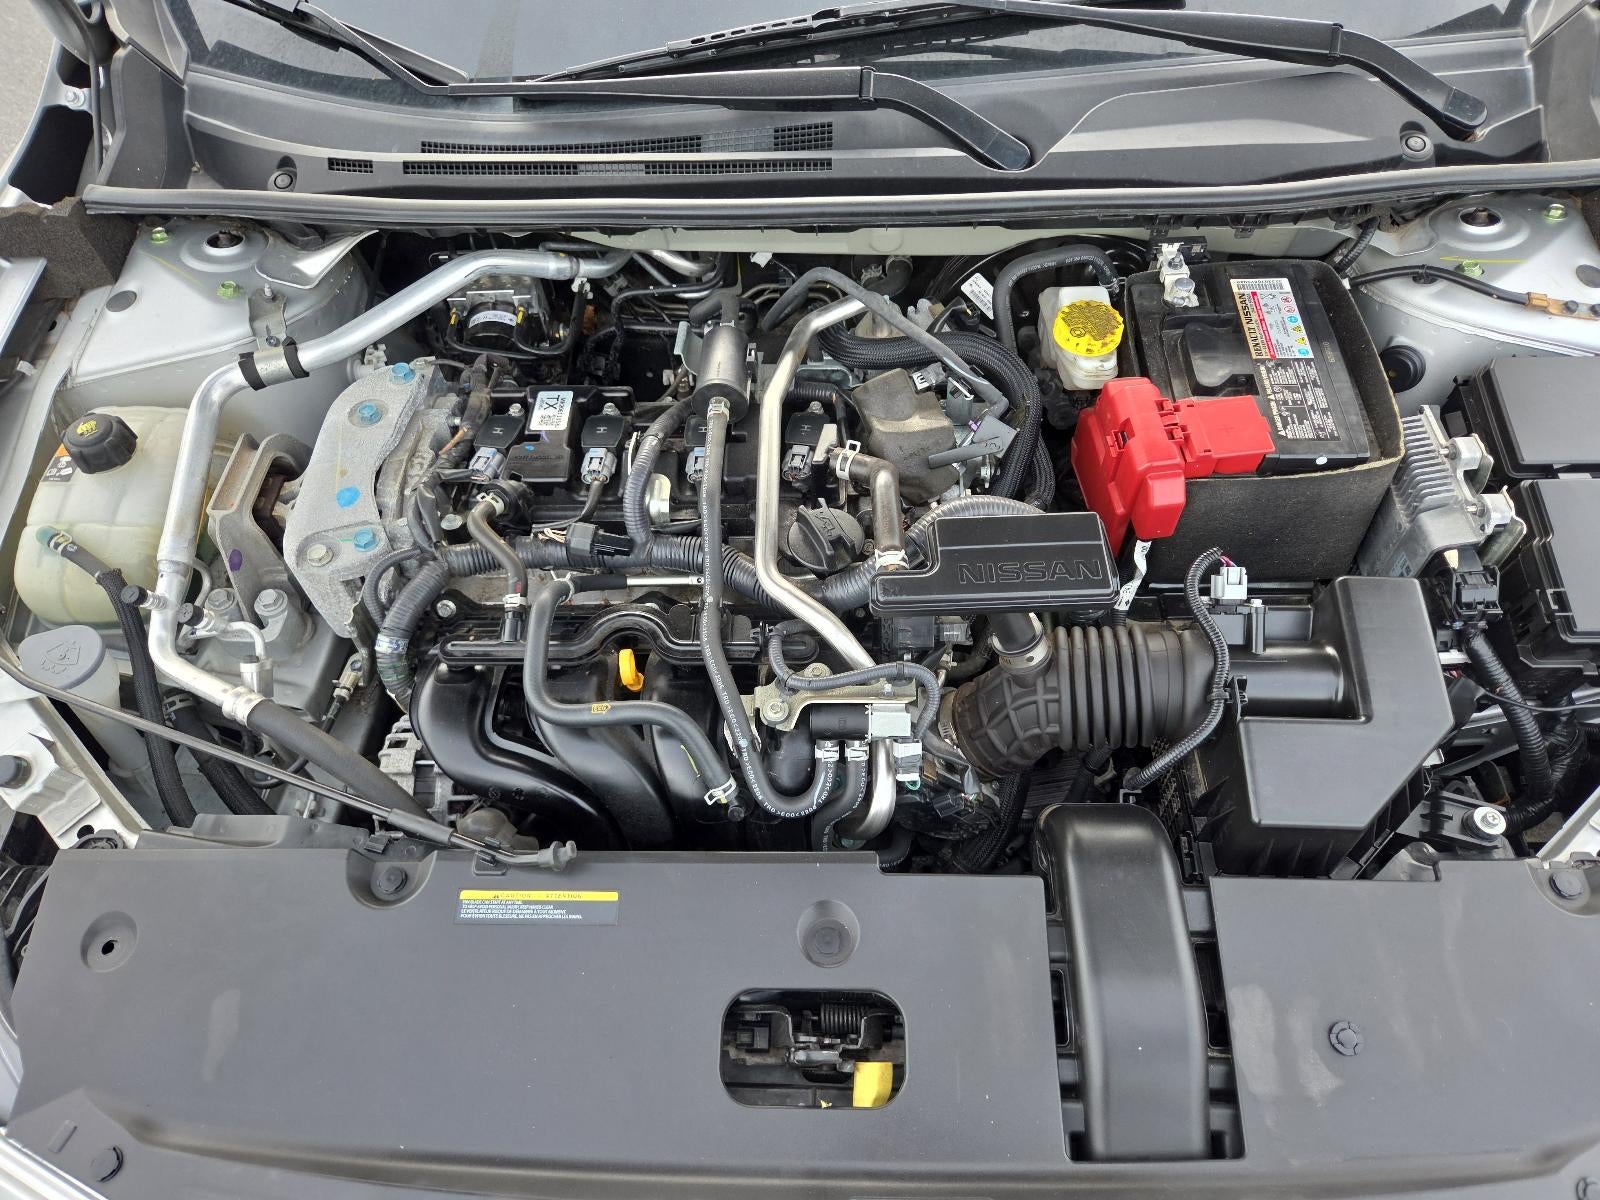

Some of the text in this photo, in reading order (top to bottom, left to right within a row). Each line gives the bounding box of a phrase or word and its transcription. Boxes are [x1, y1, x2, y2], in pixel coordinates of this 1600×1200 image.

[1239, 293, 1253, 324] NISSAN
[1249, 326, 1263, 357] RENAULT
[543, 395, 560, 411] TX
[958, 559, 1103, 584] NISSAN
